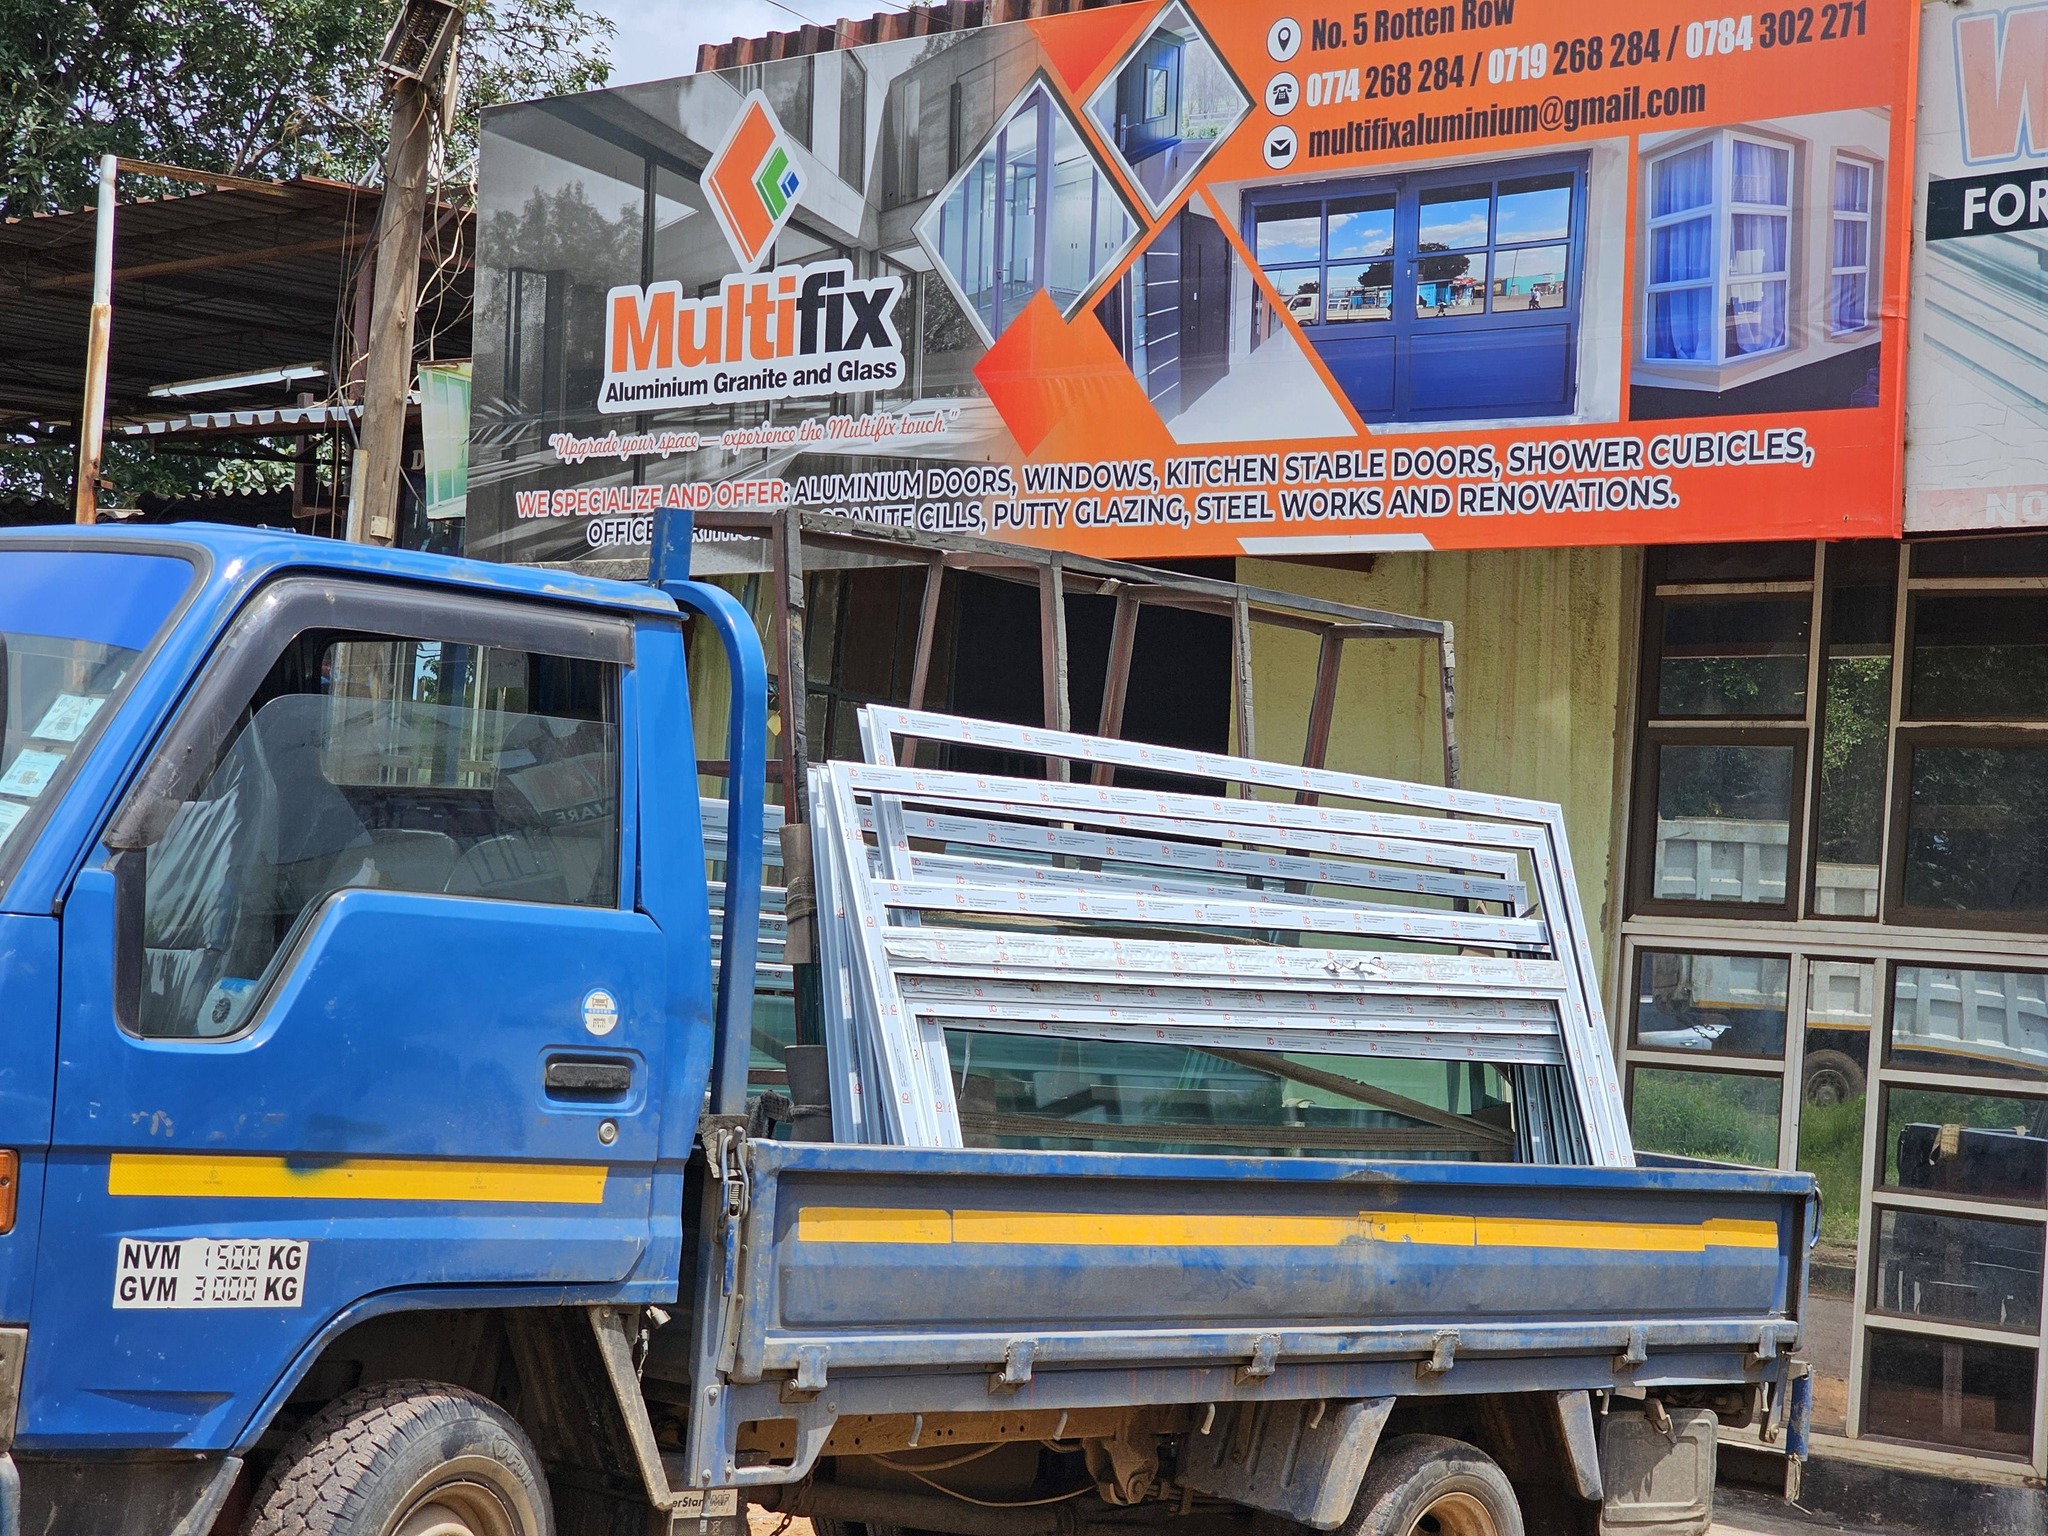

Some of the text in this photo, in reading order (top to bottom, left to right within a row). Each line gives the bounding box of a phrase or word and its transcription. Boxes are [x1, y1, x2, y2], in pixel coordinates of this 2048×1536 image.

[1312, 0, 1515, 50] No. 5 Rotten Row
[1306, 68, 1360, 108] 0774
[1365, 61, 1411, 99] 268
[1418, 55, 1464, 92] 284
[1487, 43, 1547, 84] 0719
[1553, 36, 1603, 75] 268
[1609, 28, 1660, 68] 284
[1686, 14, 1753, 59] 0784
[1759, 7, 1814, 49] 302
[1820, 0, 1867, 41] 271
[1309, 83, 1705, 158] multifixaluminium@gmail.com
[1963, 179, 2048, 231] FOR
[611, 271, 894, 373] Multifix
[605, 360, 897, 403] Aluminium Granite and Glass
[621, 436, 653, 460] your
[657, 434, 698, 458] space
[722, 425, 796, 454] experience
[799, 420, 822, 441] the
[829, 416, 896, 442] Multifix
[518, 431, 1813, 515] WE SPECIALIZE AND OFFER: ALUMINIUM DOORS, WINDOWS, KITCHEN STABLE DOORS, SHOWER CUBICLES,
[920, 504, 986, 532] CILLS,
[994, 501, 1069, 527] PUTTY
[1077, 497, 1190, 528] GLAZING,
[1197, 495, 1273, 520] STEEL
[1282, 490, 1381, 517] WORKS
[1389, 487, 1450, 514] AND
[1460, 478, 1678, 513] RENOVATIONS.
[123, 1244, 302, 1270] NVM 1500 KG
[120, 1276, 298, 1301] GVM 3000 KG
